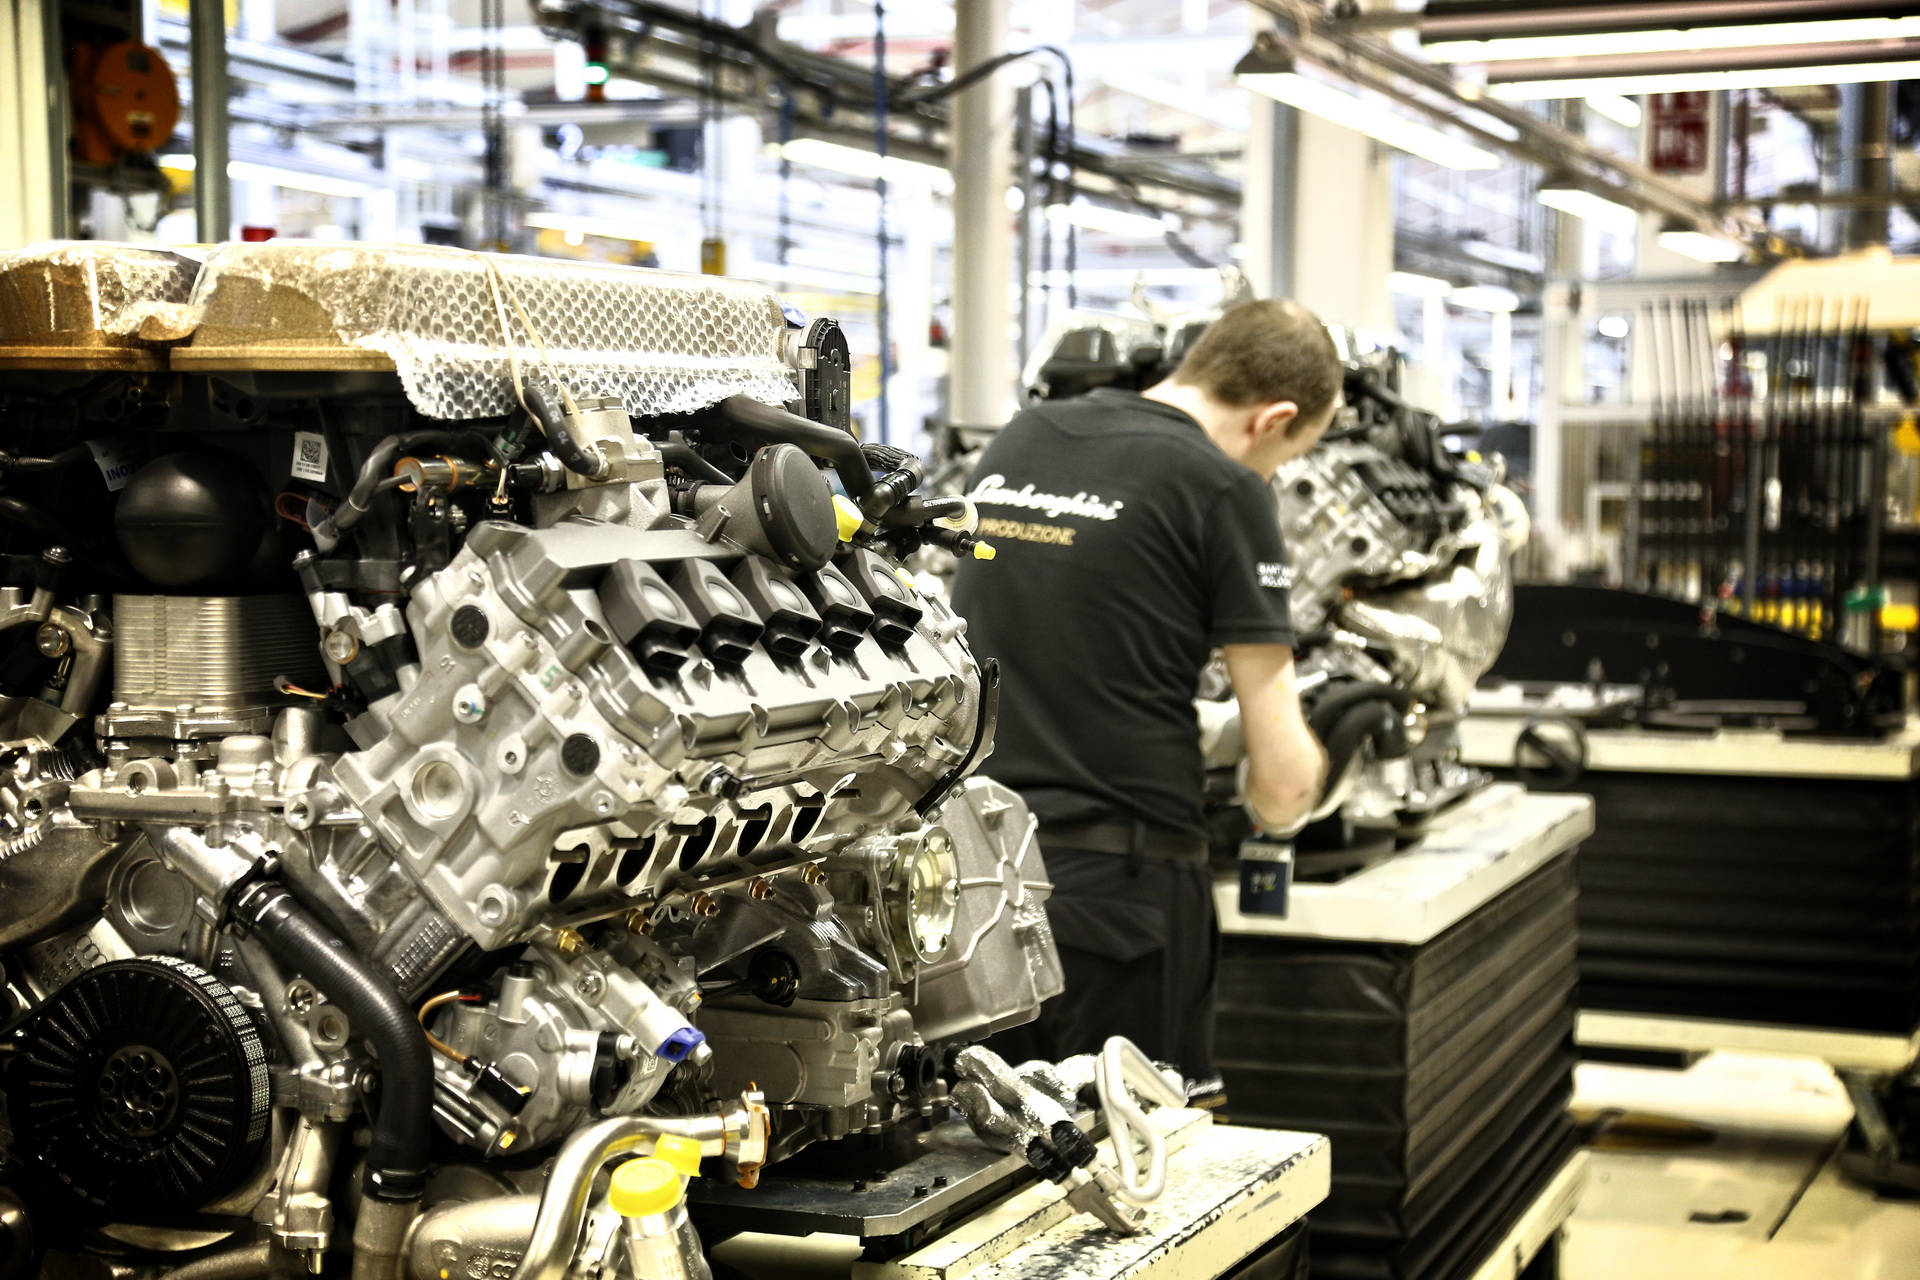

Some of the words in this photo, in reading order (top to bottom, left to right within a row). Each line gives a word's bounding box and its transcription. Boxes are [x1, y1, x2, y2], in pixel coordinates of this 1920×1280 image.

[557, 430, 570, 445] 04
[965, 473, 1124, 521] Lamborghini
[979, 517, 1077, 545] PRODUZIONE
